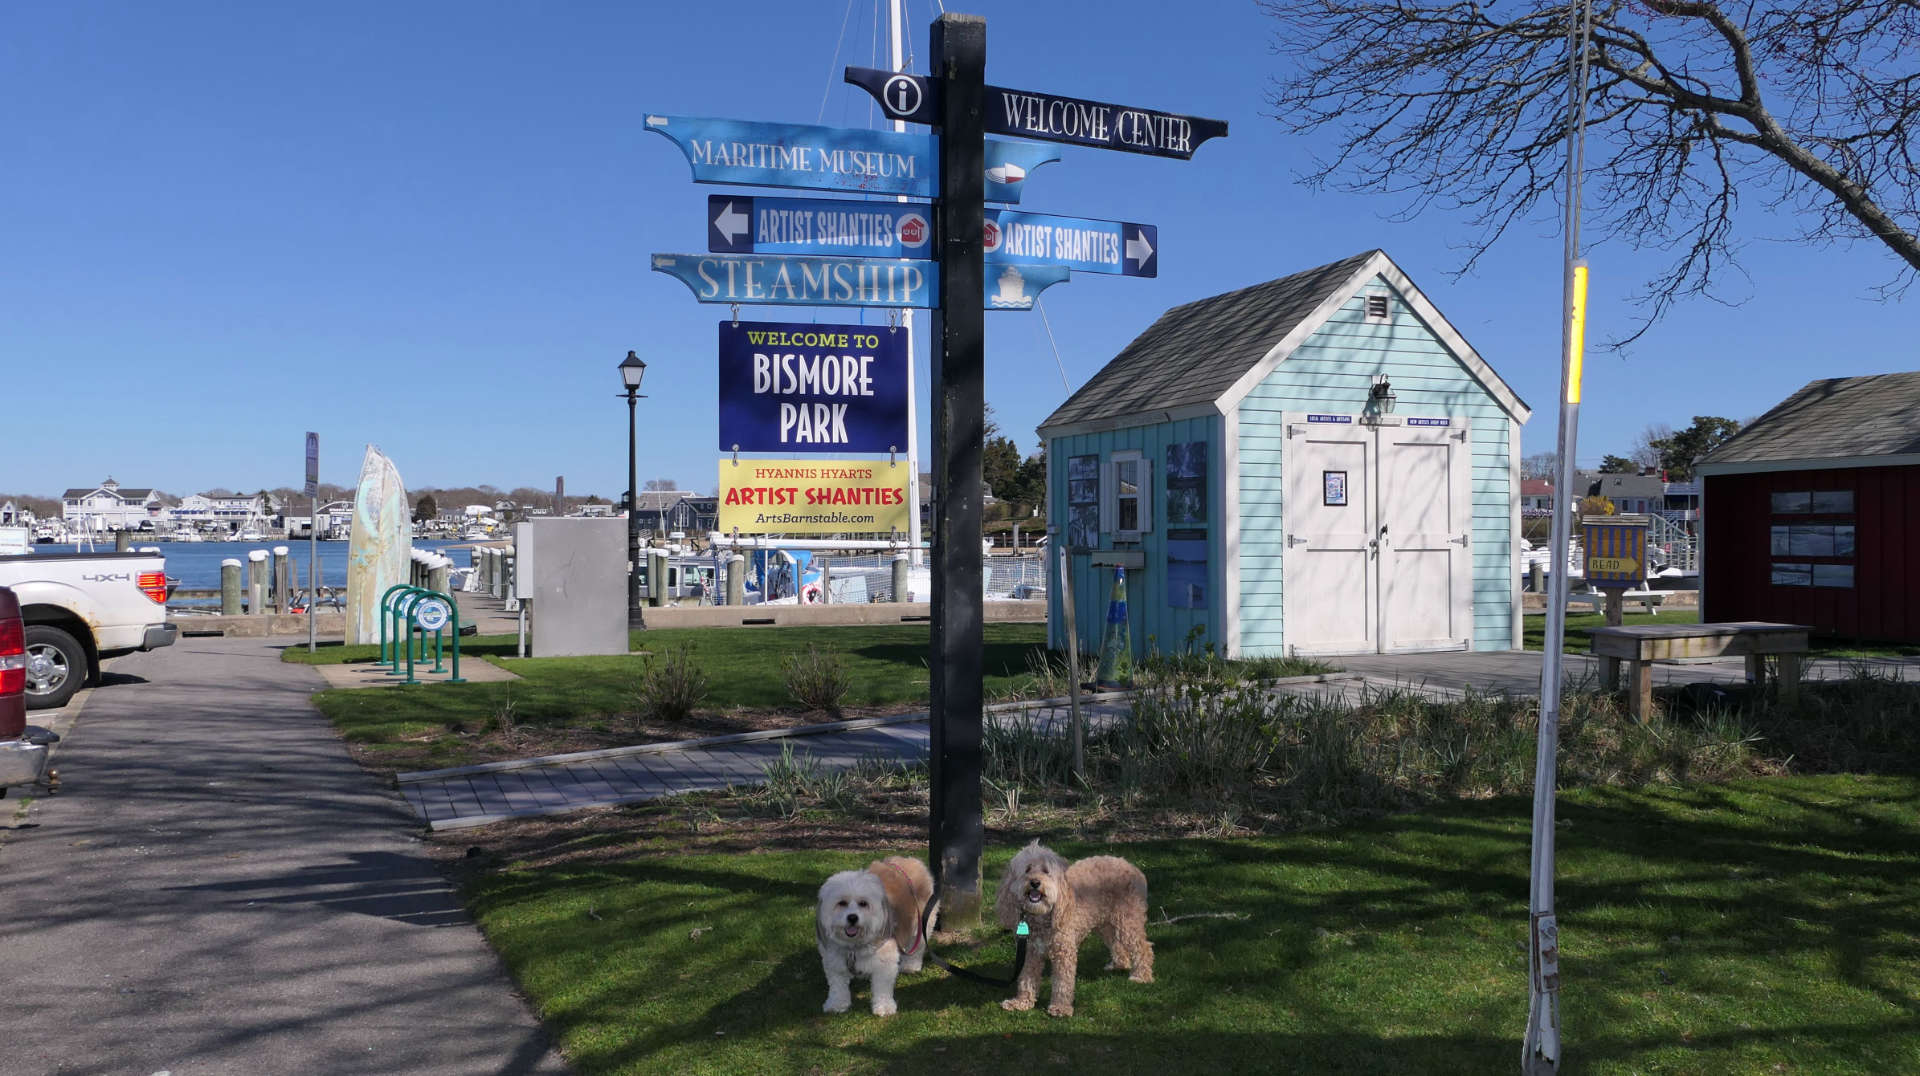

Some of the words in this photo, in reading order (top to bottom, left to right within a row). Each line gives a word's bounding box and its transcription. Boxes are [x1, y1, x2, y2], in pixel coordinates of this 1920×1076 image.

[1002, 92, 1110, 142] WELCOME
[1117, 110, 1191, 153] CENTER
[691, 139, 812, 173] MARITIME
[814, 148, 915, 179] MUSEUM
[758, 208, 813, 244] ARTIST
[817, 210, 892, 248] SHANTIES
[1005, 222, 1052, 258] ARTIST
[1055, 227, 1119, 265] SHANTIES
[698, 258, 923, 303] STEAMSHIP
[747, 331, 848, 348] WELCOME
[853, 334, 880, 349] TO
[753, 353, 875, 397] BISMORE
[780, 402, 849, 444] PARK
[755, 468, 817, 479] HYANNIS
[820, 468, 873, 480] HYARTS
[725, 487, 799, 506] ARTIST
[804, 486, 904, 506] SHANTIES
[755, 511, 875, 524] ArtsBarnstable.com
[1592, 559, 1620, 570] READ
